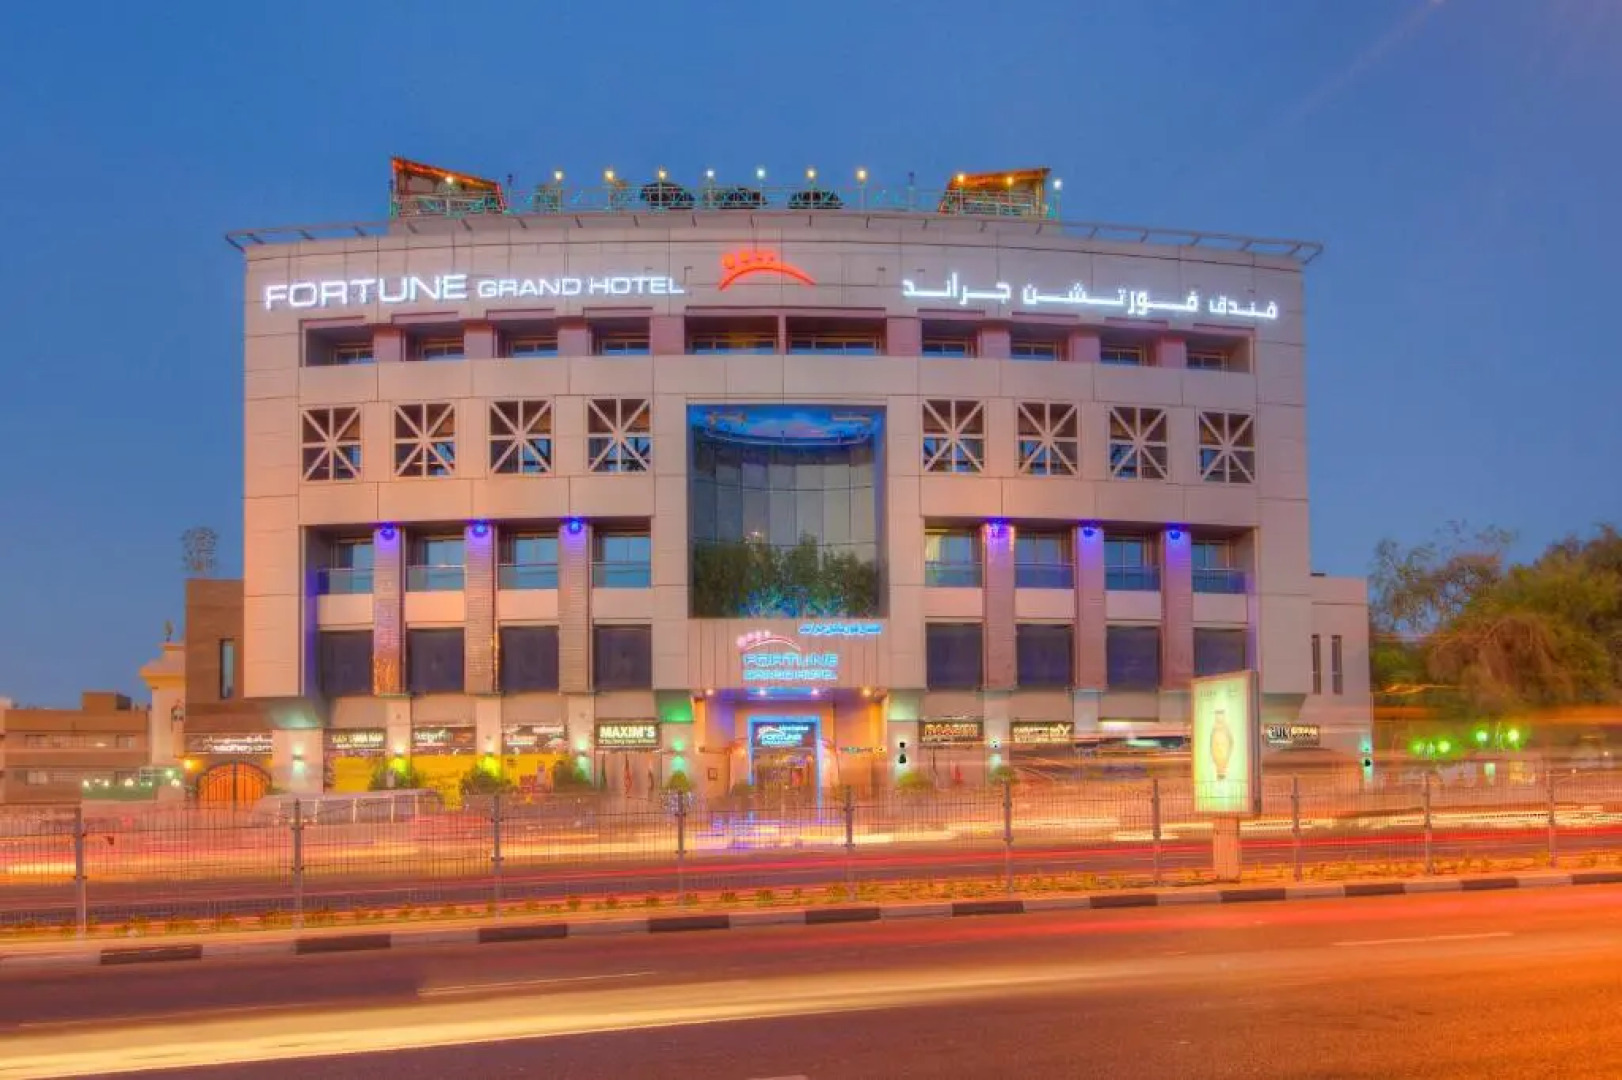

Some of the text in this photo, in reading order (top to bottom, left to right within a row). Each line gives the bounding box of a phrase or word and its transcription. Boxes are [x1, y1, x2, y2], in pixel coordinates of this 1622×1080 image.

[264, 273, 685, 310] FORTUNE GRAND HOTEL
[902, 272, 1012, 306] جراند
[1209, 296, 1278, 319] فندق
[599, 725, 656, 739] MAXIM'S
